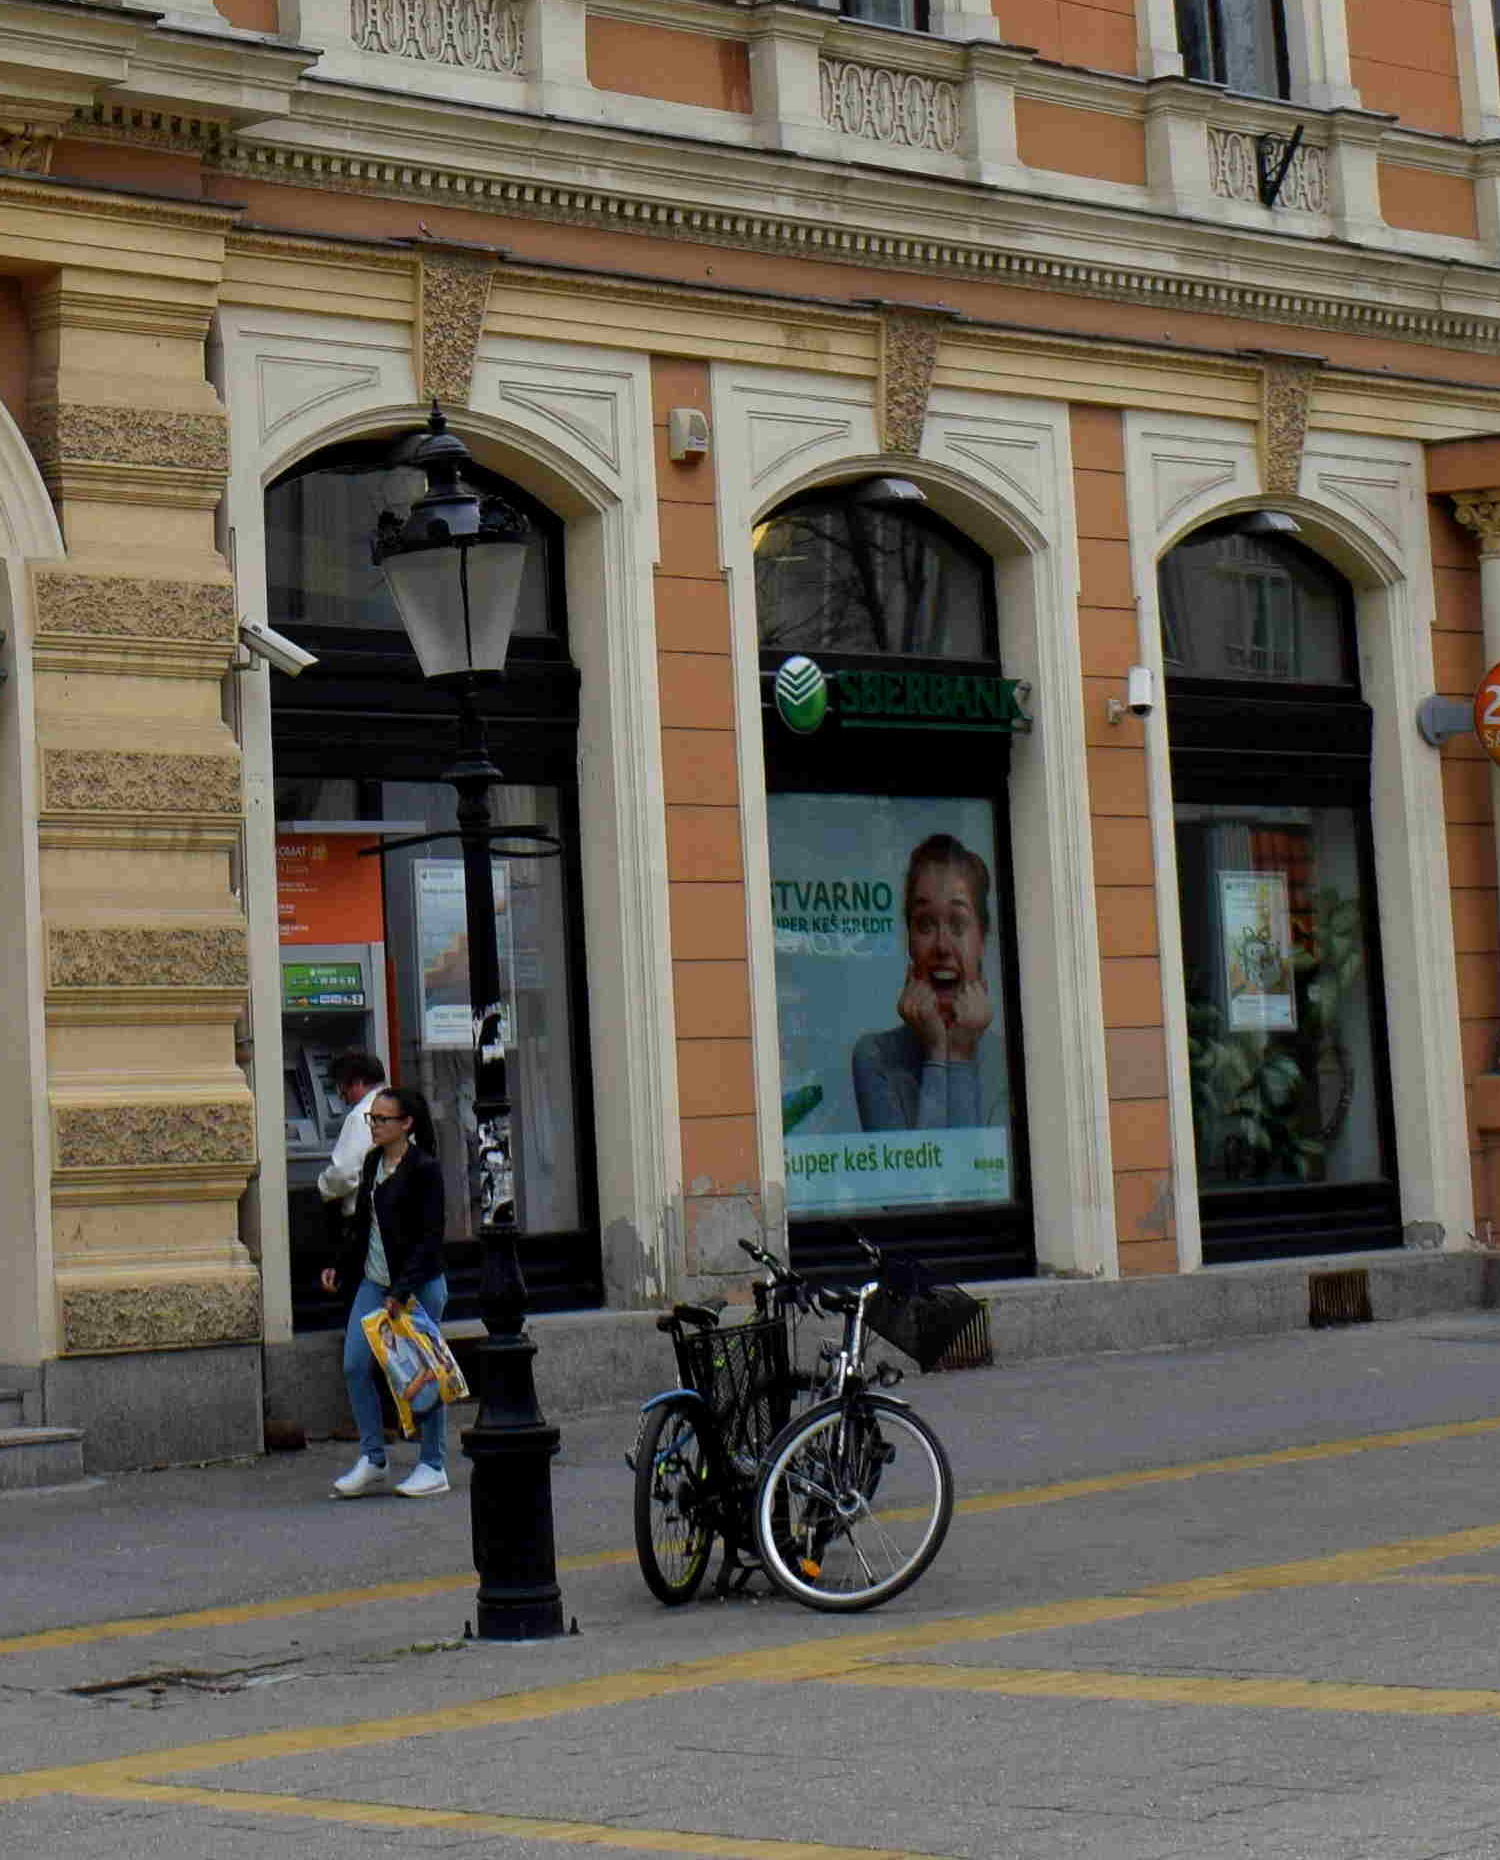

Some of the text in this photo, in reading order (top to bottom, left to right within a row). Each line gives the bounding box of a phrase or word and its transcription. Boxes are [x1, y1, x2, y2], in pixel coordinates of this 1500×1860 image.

[839, 670, 1023, 720] SBERBANK
[812, 913, 839, 933] KEŠ
[842, 916, 894, 933] KREDIT
[843, 1142, 878, 1172] keš
[882, 1141, 943, 1172] kredit
